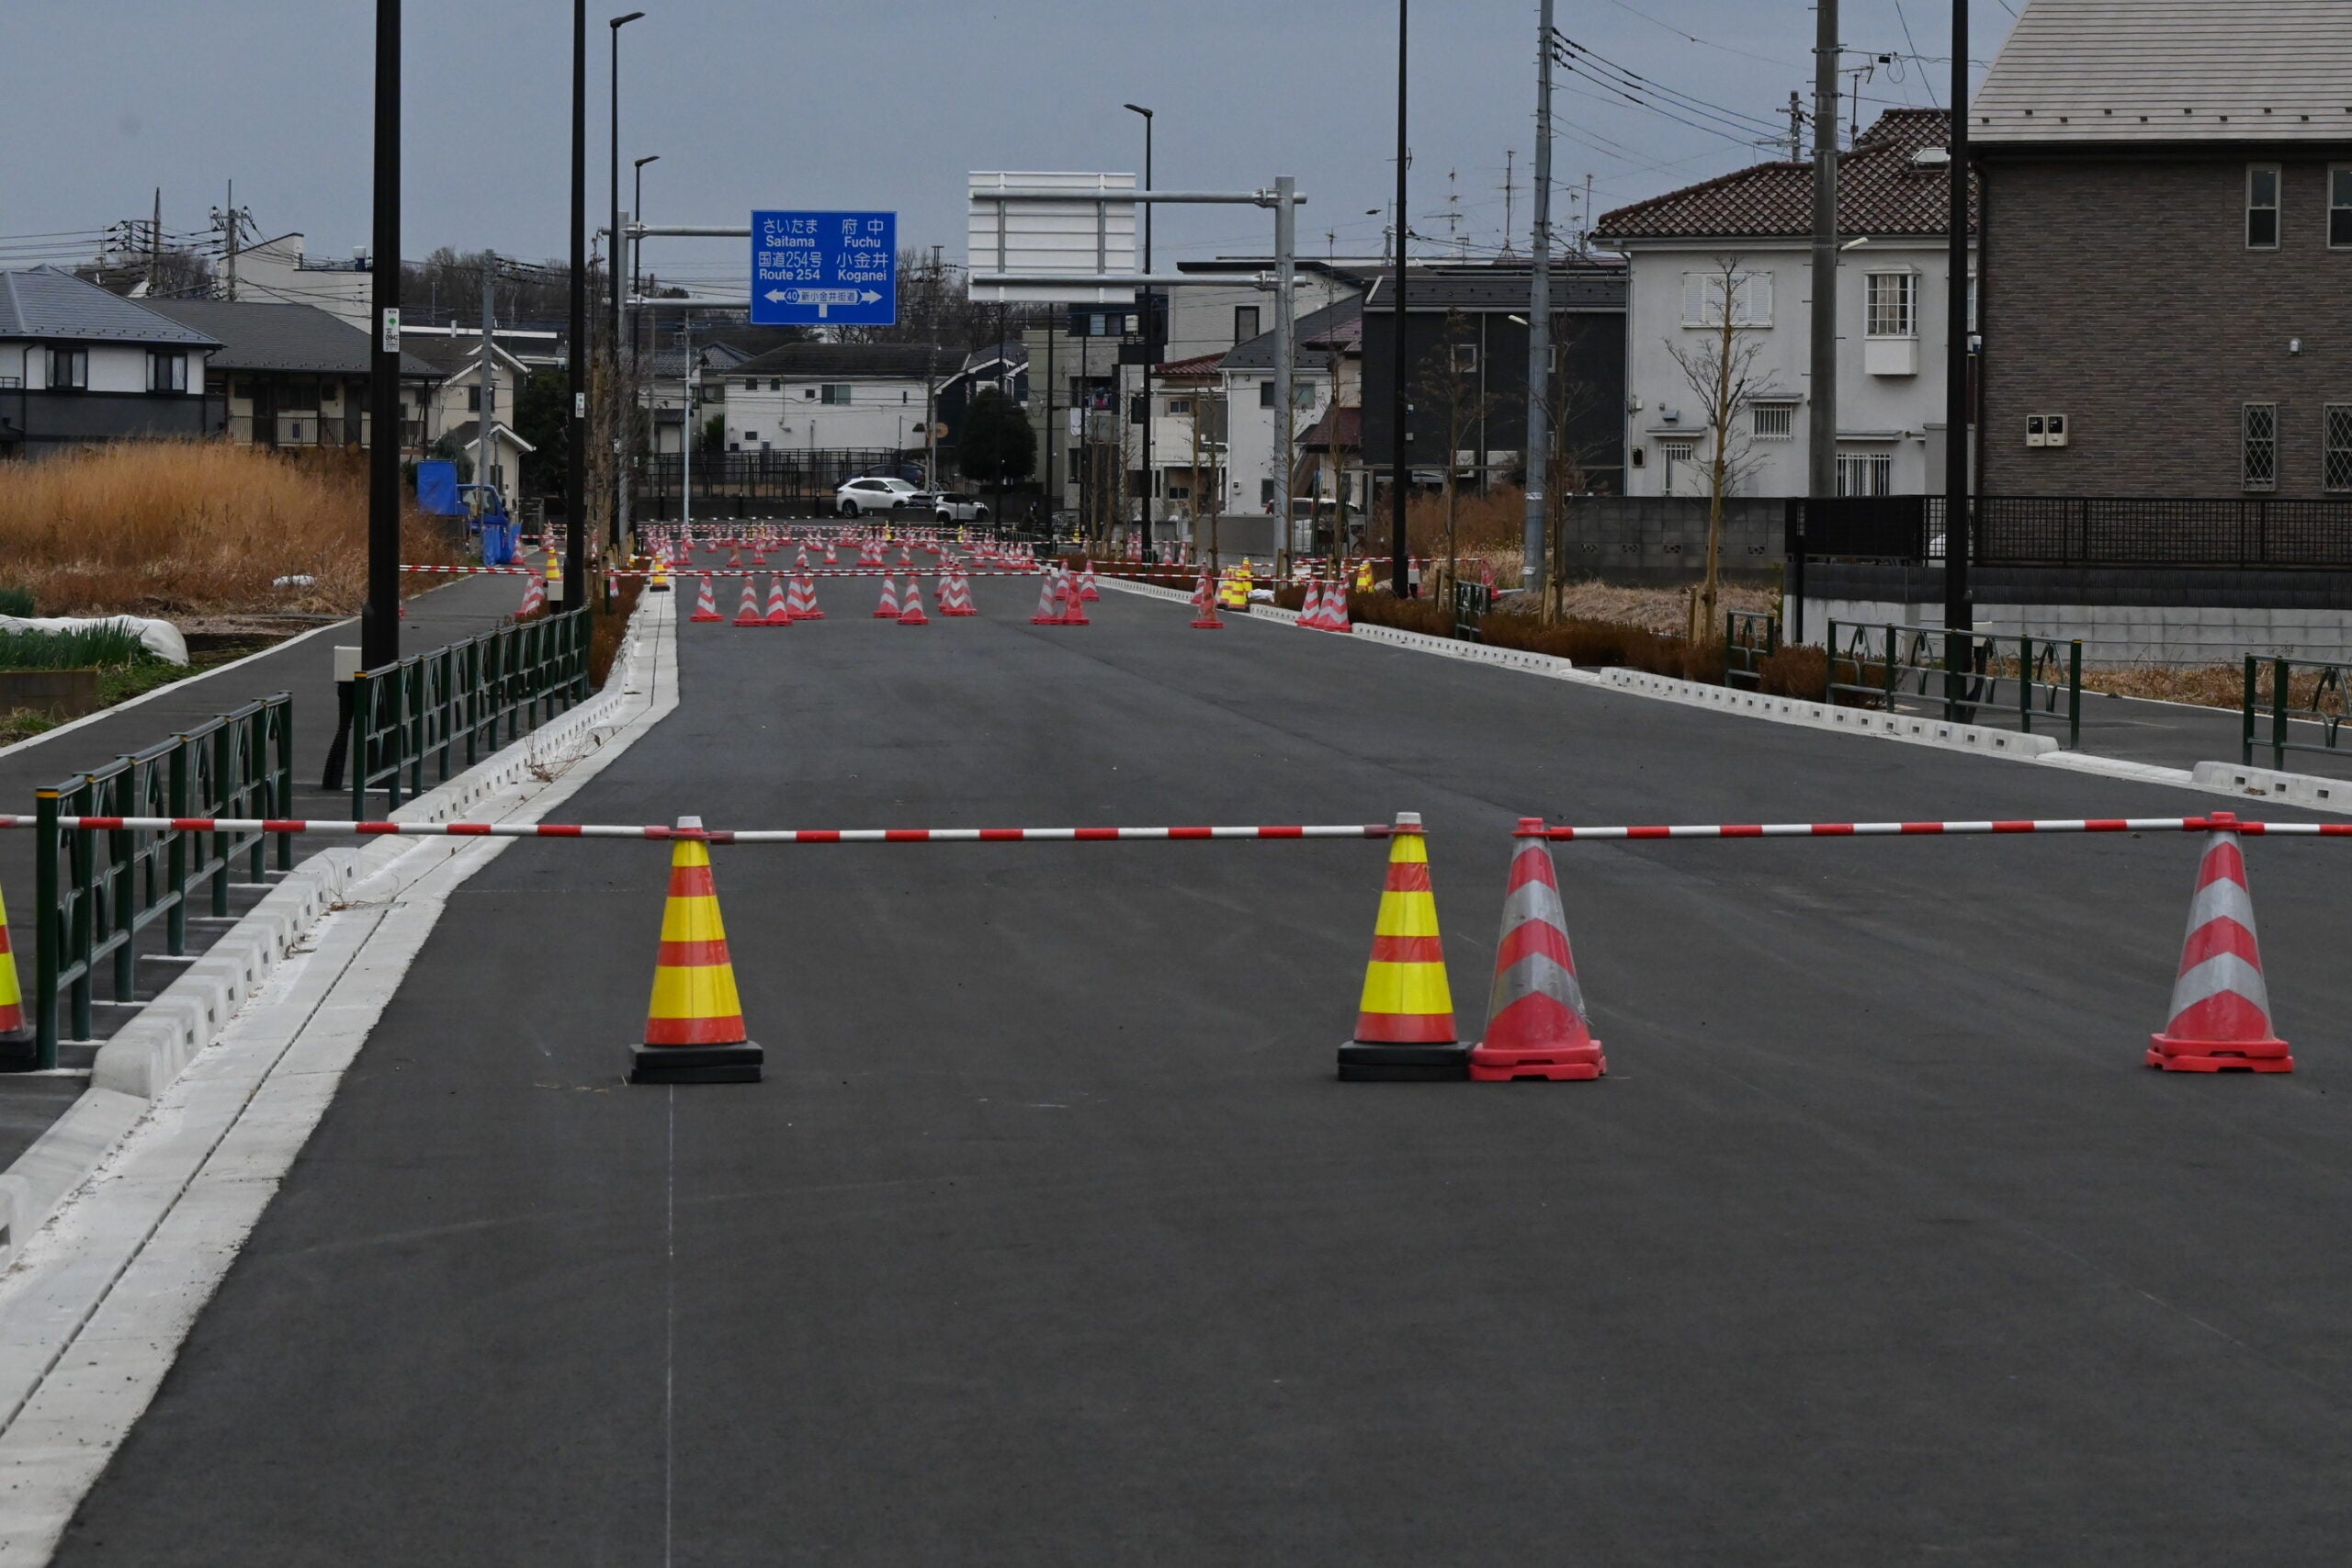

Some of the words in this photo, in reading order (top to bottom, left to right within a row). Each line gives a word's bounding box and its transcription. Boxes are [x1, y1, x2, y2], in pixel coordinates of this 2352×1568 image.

[763, 219, 818, 234] さいたま
[842, 219, 884, 235] 府中
[765, 235, 815, 247] Saitama
[844, 236, 881, 248] Fuchu
[759, 251, 822, 268] 国道254号
[836, 252, 889, 268] 小金井
[759, 269, 794, 280] Route
[796, 269, 821, 281] 254
[838, 269, 887, 283] Koganei
[786, 291, 797, 301] 40
[801, 291, 855, 301] 新小金井街道
